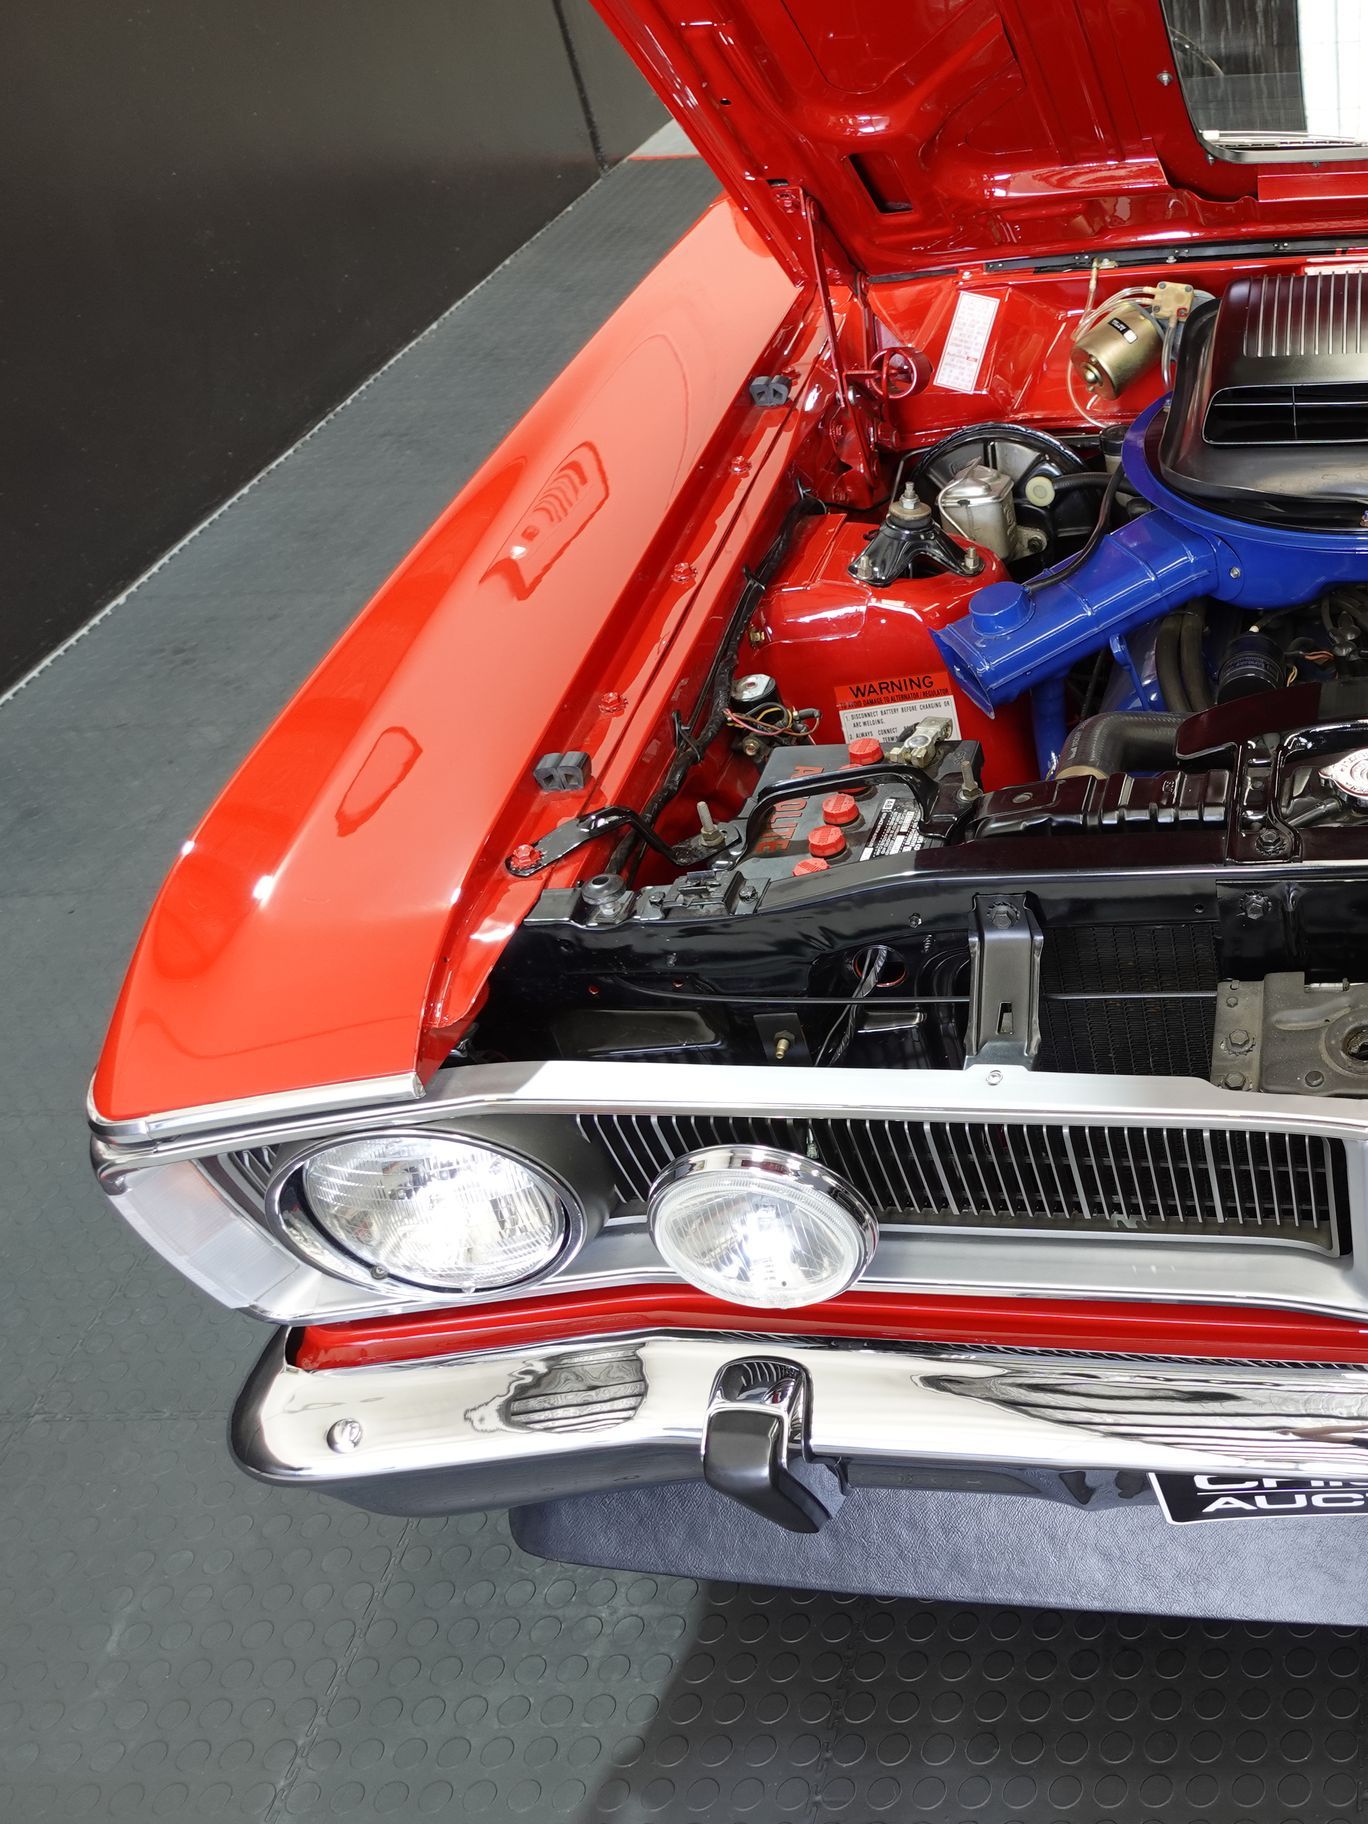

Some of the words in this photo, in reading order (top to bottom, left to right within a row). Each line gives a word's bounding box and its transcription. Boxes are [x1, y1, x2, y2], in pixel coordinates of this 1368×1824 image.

[849, 675, 934, 698] WARNING
[851, 710, 879, 720] DISCONNECT
[880, 708, 899, 716] BATTERY
[901, 705, 917, 713] BEFORE
[919, 702, 942, 711] CHARGING
[855, 731, 873, 739] ALWAYS
[877, 727, 898, 736] CONNECT
[755, 765, 824, 853] AOLITE
